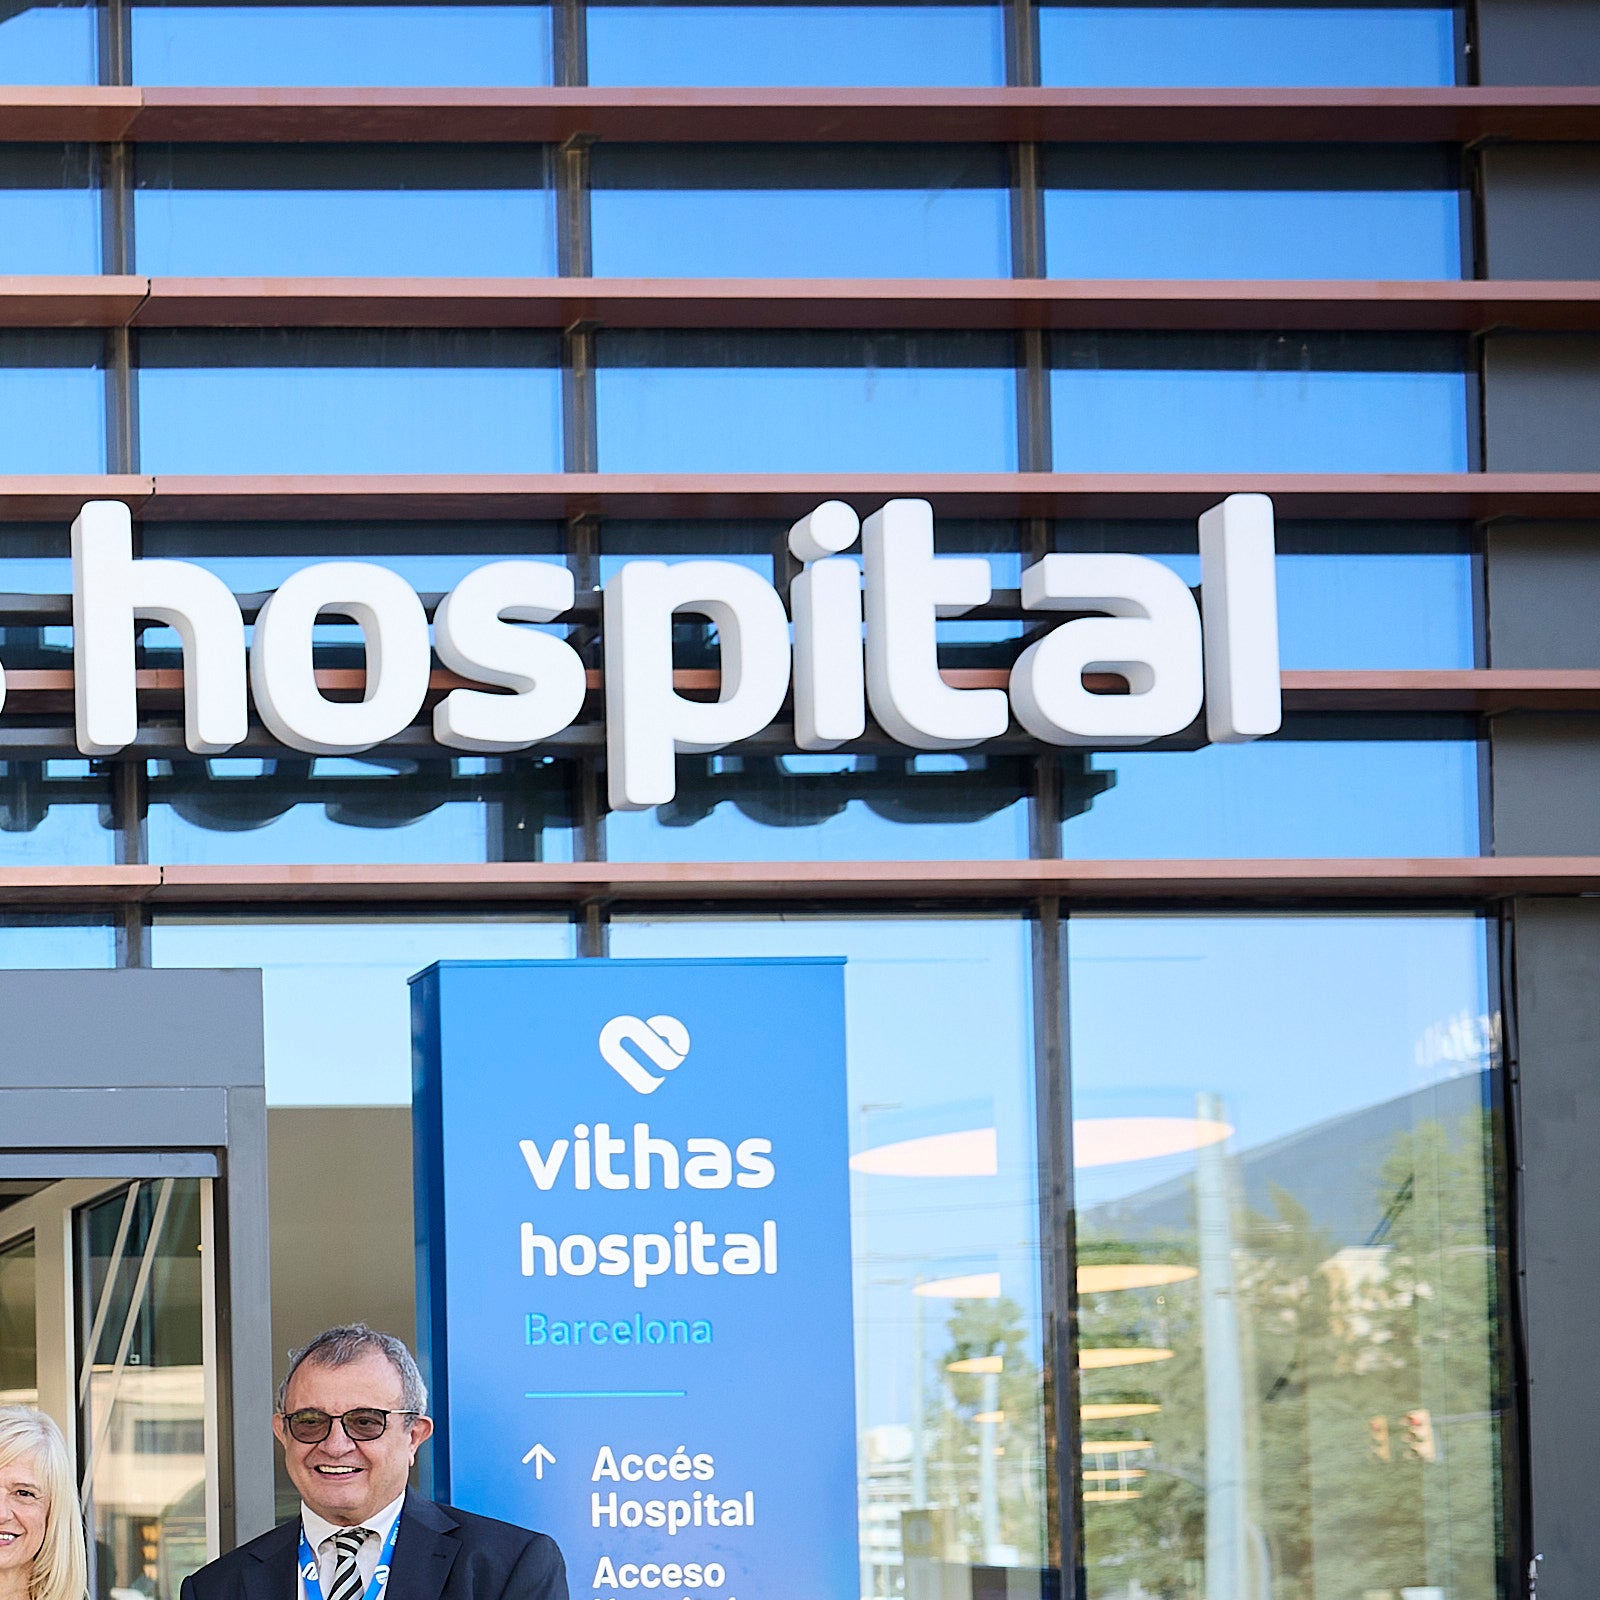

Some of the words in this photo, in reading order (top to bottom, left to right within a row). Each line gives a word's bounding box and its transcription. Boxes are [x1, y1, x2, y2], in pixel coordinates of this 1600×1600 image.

[71, 493, 1282, 810] hospital
[519, 1123, 776, 1191] vithas
[520, 1220, 778, 1288] hospital
[524, 1313, 713, 1346] Barcelona
[591, 1445, 714, 1482] Accés
[591, 1491, 755, 1535] Hospital
[592, 1556, 726, 1589] Acceso
